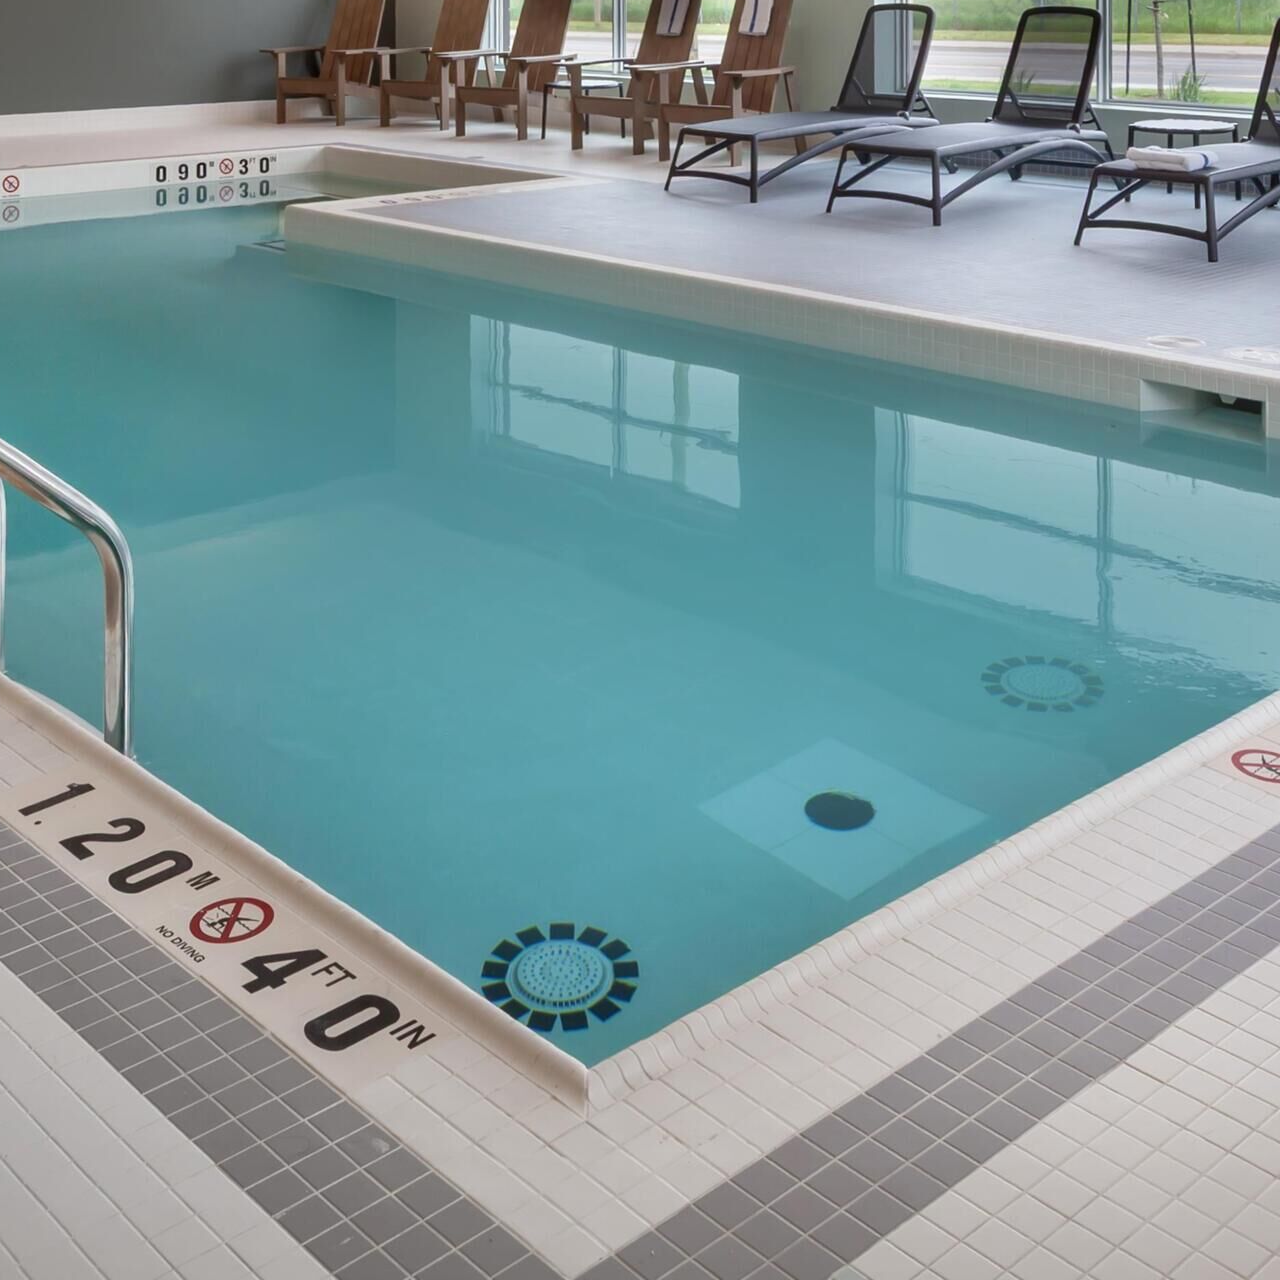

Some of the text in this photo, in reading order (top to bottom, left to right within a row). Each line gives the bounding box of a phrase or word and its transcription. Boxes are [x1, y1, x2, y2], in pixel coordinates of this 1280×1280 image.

[239, 158, 248, 175] 3
[260, 157, 269, 173] 0
[155, 924, 206, 963] NO DIVING
[240, 948, 437, 1052] 4 FT 0 IN
